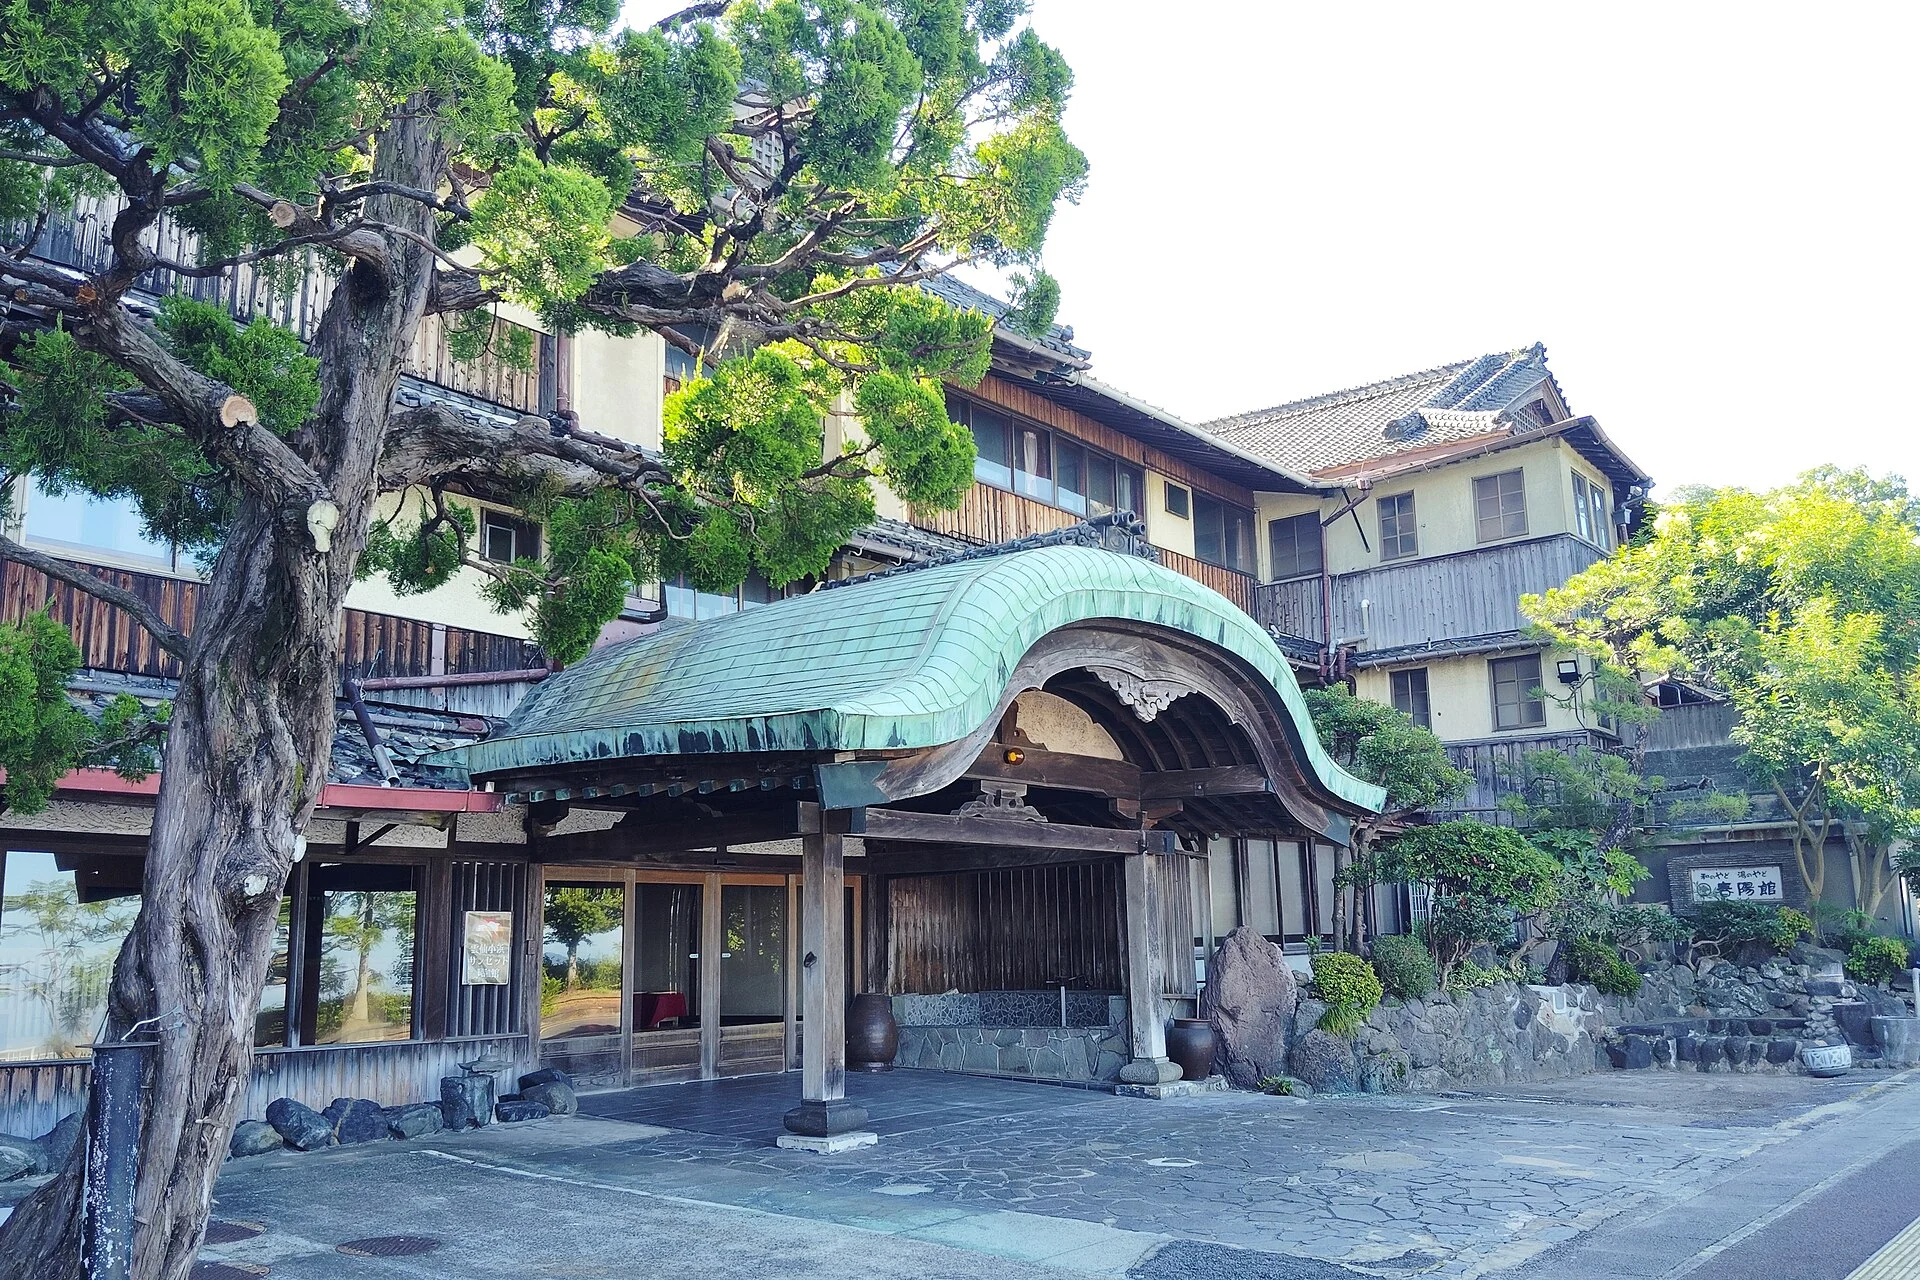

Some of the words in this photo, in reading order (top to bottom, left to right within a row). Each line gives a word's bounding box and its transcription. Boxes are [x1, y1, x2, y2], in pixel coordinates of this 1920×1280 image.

[1700, 872, 1730, 880] 和のやど
[1737, 870, 1767, 879] 湯のやど
[1716, 881, 1776, 898] 春陽館
[470, 956, 508, 965] サンセット
